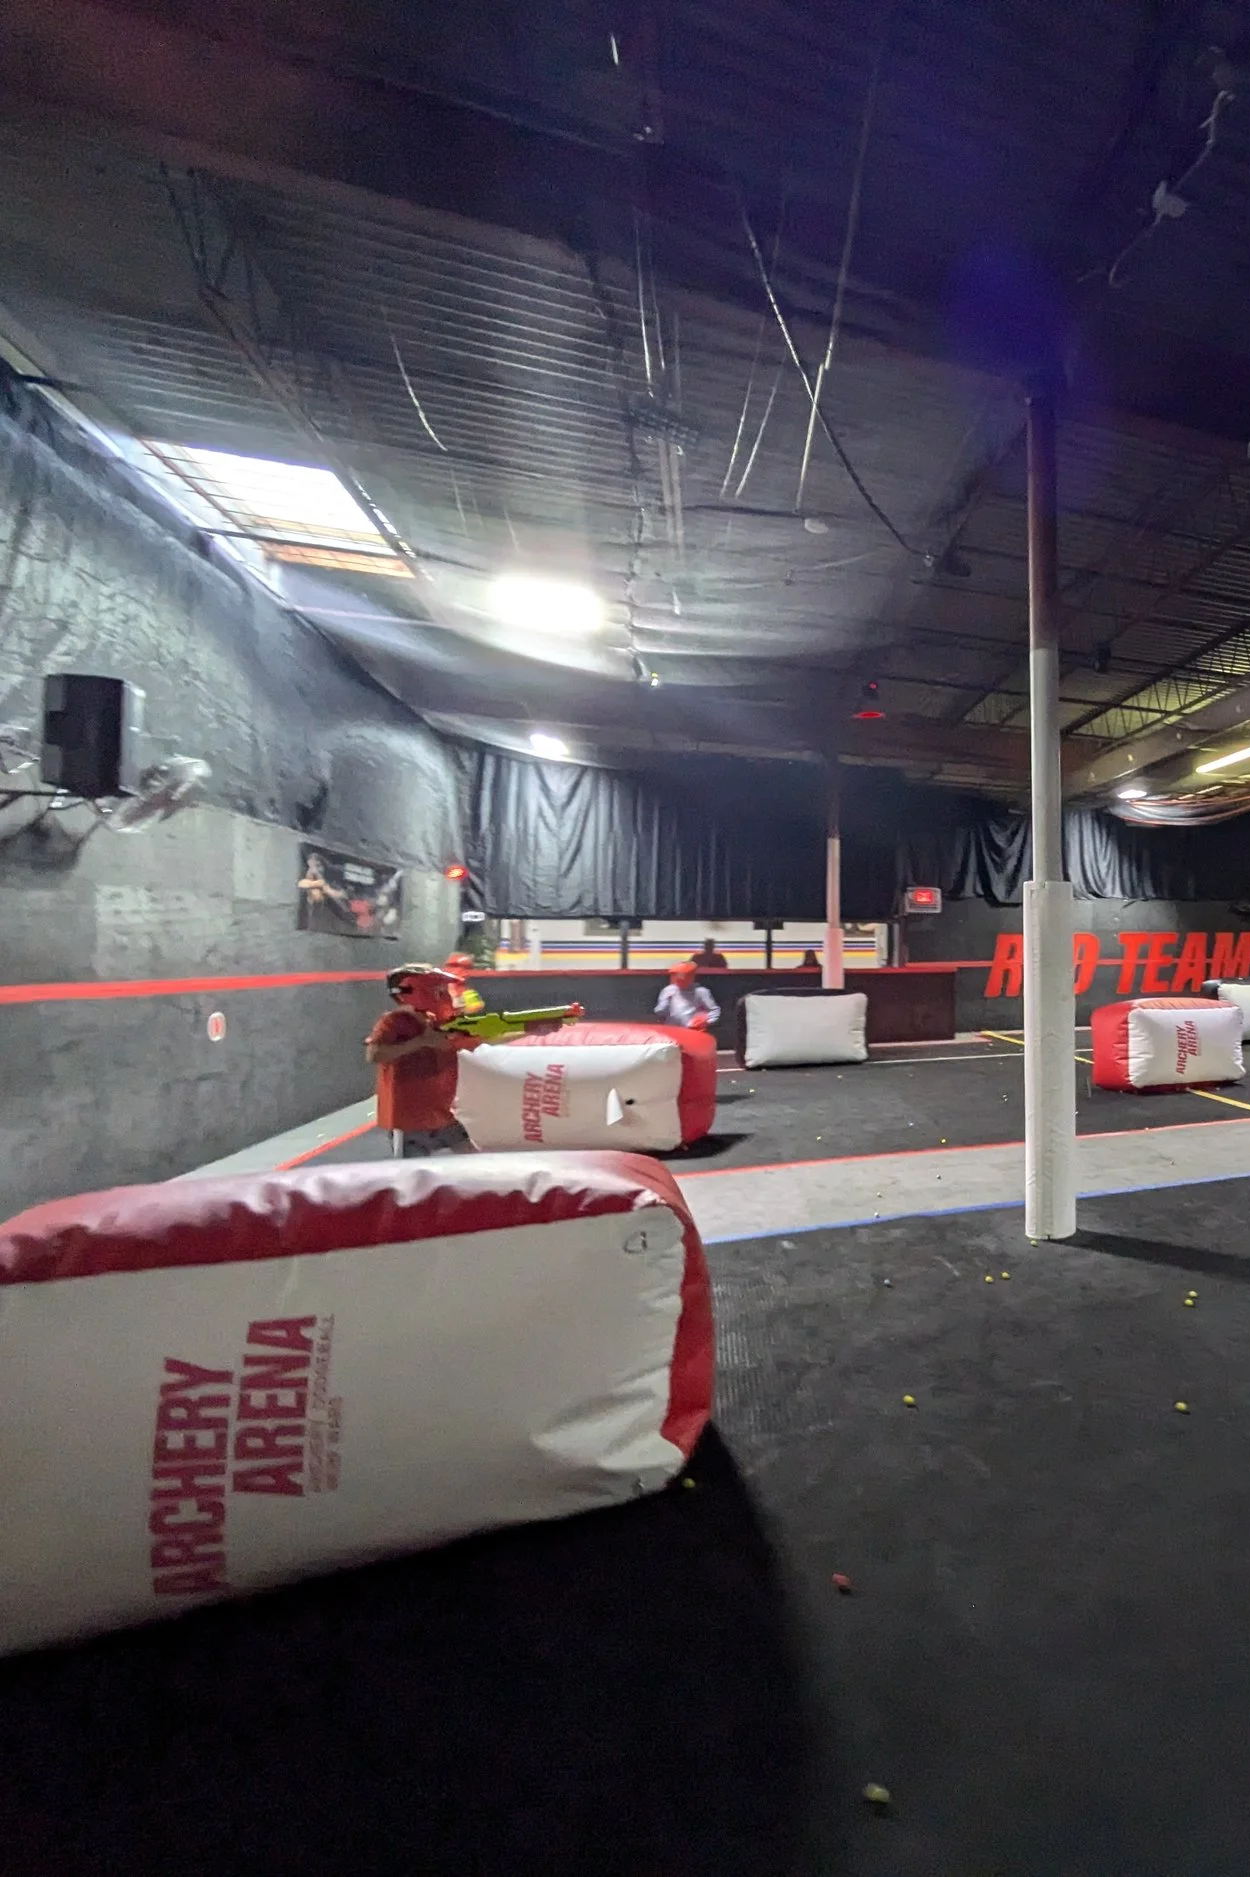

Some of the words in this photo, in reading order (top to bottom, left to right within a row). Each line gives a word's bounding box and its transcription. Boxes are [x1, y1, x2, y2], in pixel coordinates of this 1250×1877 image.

[984, 932, 1100, 997] RD
[1175, 1024, 1188, 1075] ARCHERY
[1184, 1020, 1198, 1057] ARENA
[522, 1071, 544, 1143] ARCHERY
[541, 1064, 564, 1117] ARENA
[231, 1314, 317, 1497] ARENA
[148, 1356, 234, 1596] ARCHERY
